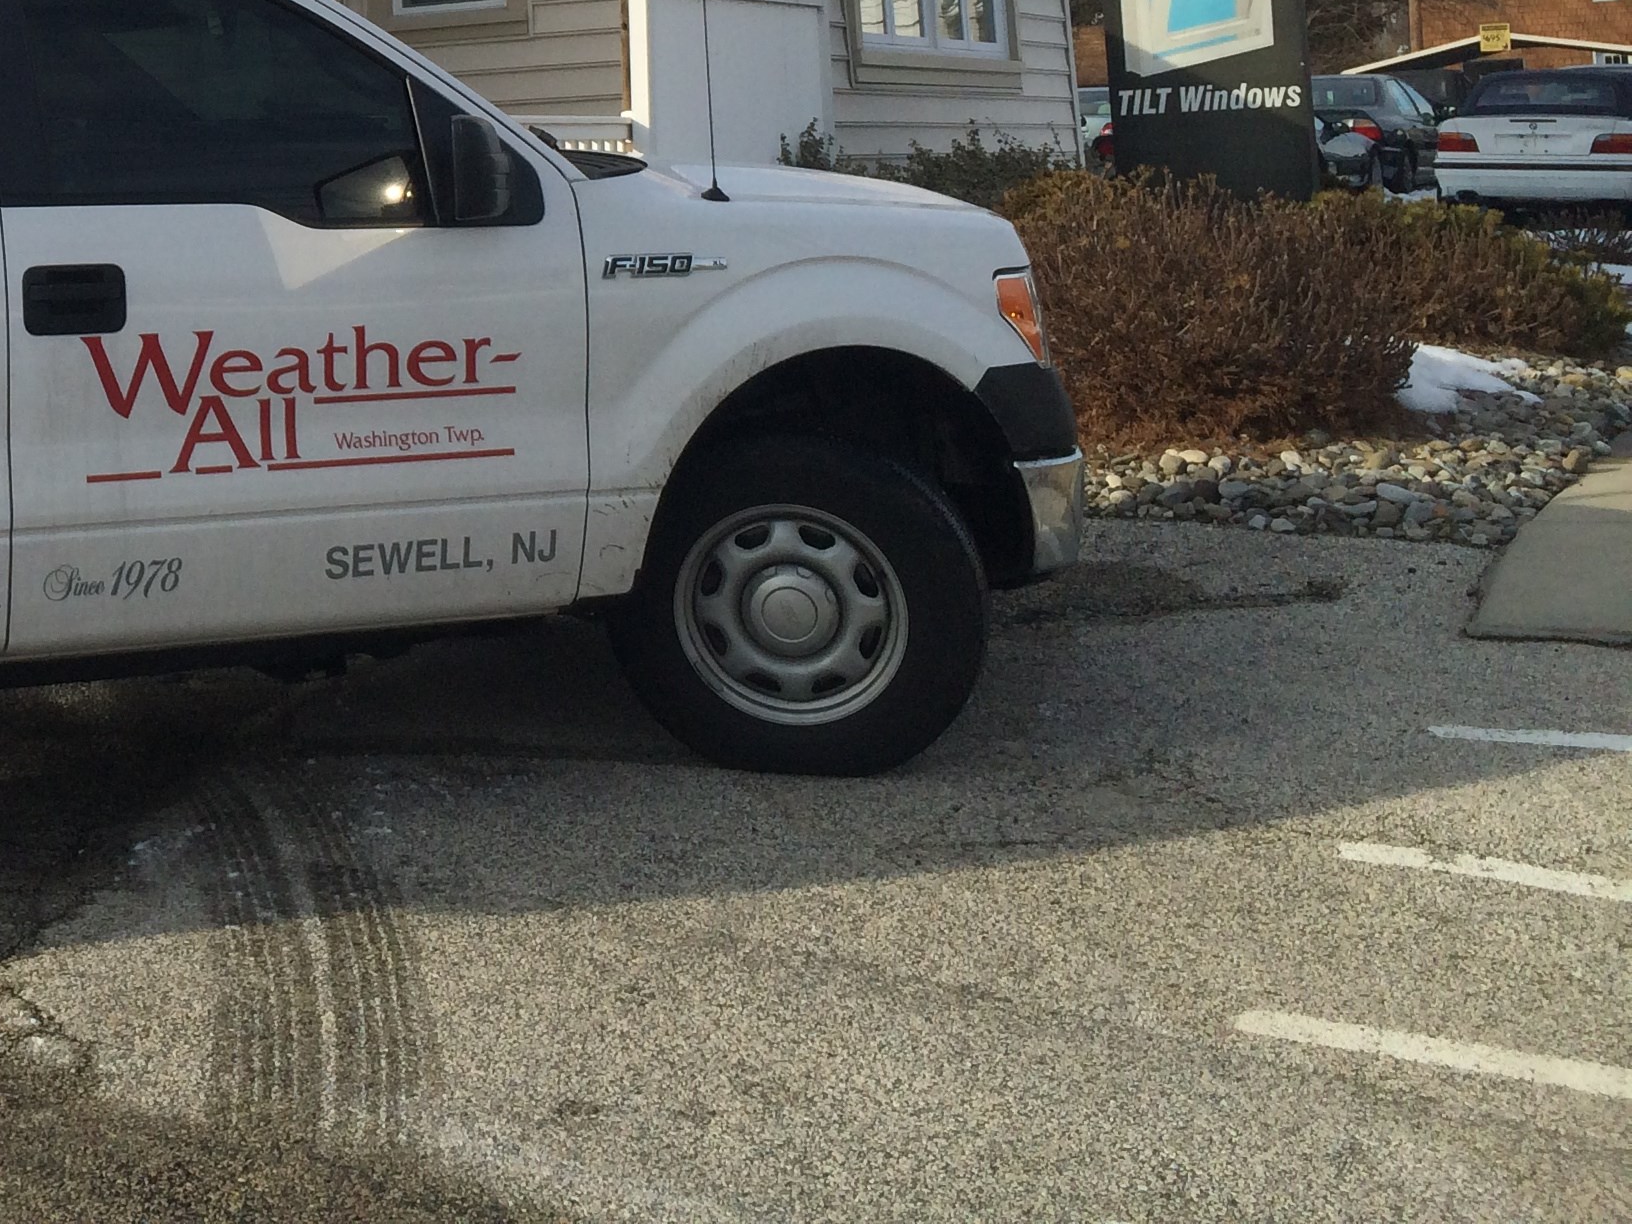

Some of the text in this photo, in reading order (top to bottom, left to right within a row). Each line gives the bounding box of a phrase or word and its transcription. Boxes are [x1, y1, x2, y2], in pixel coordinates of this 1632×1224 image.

[1118, 81, 1302, 116] TILT Windows
[80, 325, 523, 419] Weather-
[169, 396, 299, 473] All
[334, 426, 485, 451] Washington Twp.
[324, 529, 558, 580] SEWELL, NJ
[43, 557, 183, 601] Since 1978
